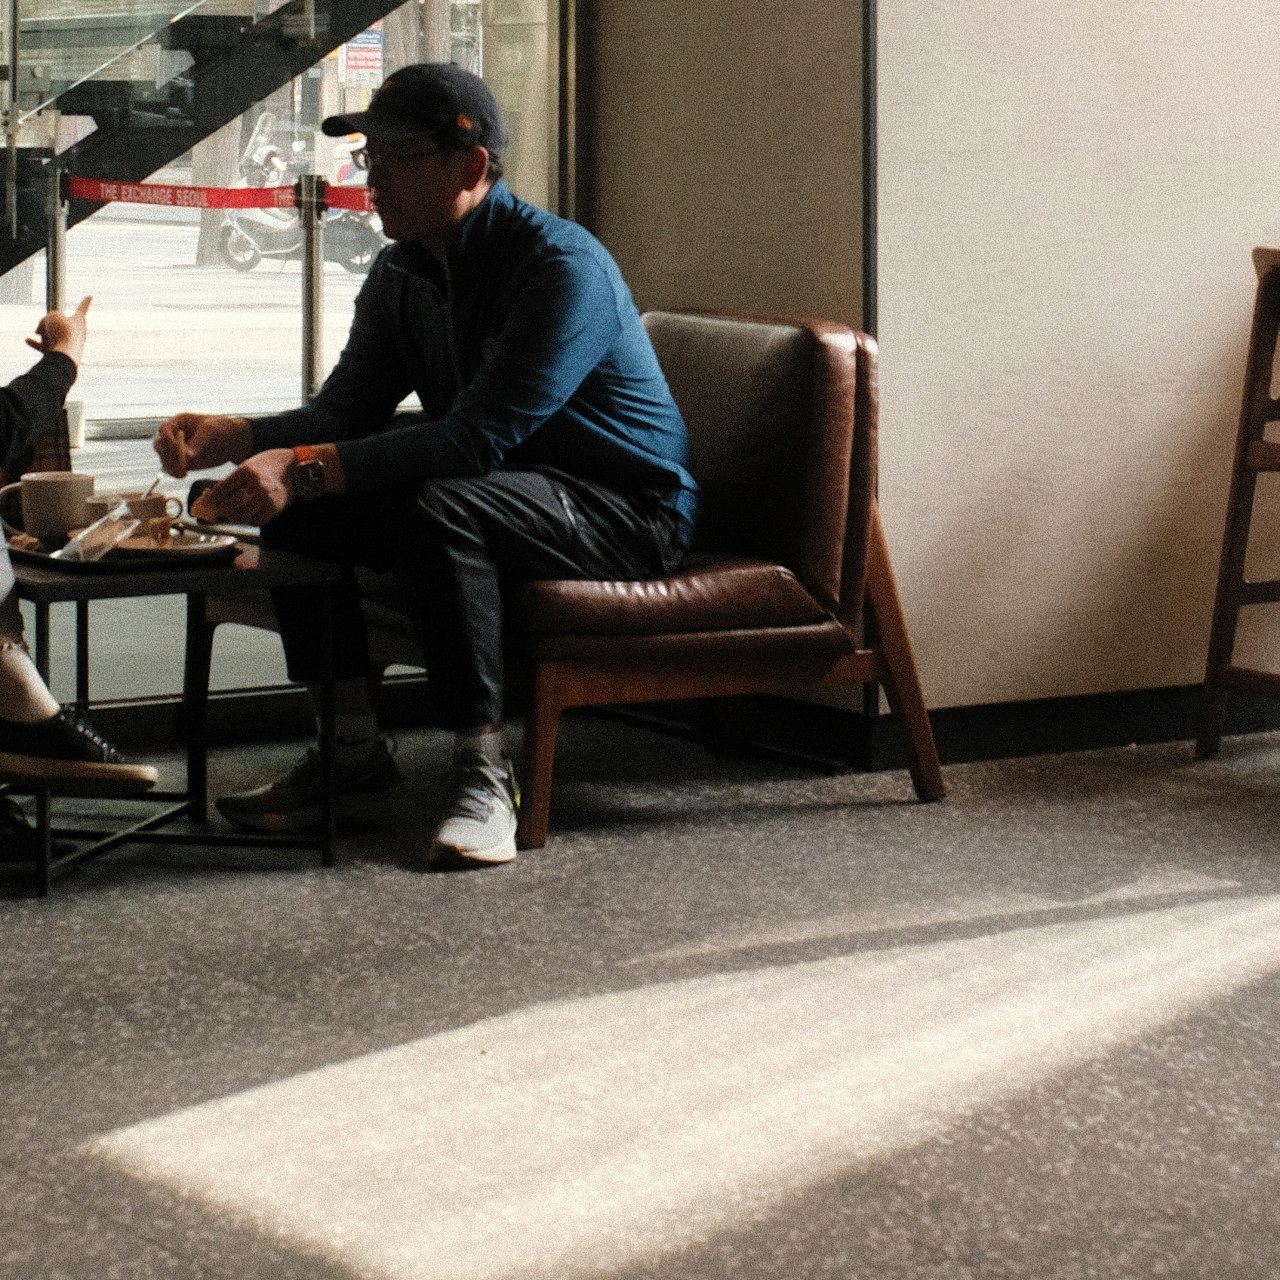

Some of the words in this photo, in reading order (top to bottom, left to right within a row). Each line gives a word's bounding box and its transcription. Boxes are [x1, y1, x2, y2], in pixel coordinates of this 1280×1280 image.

[100, 183, 117, 201] THE
[121, 185, 172, 205] EXCHANGE
[176, 190, 208, 207] SEOUL
